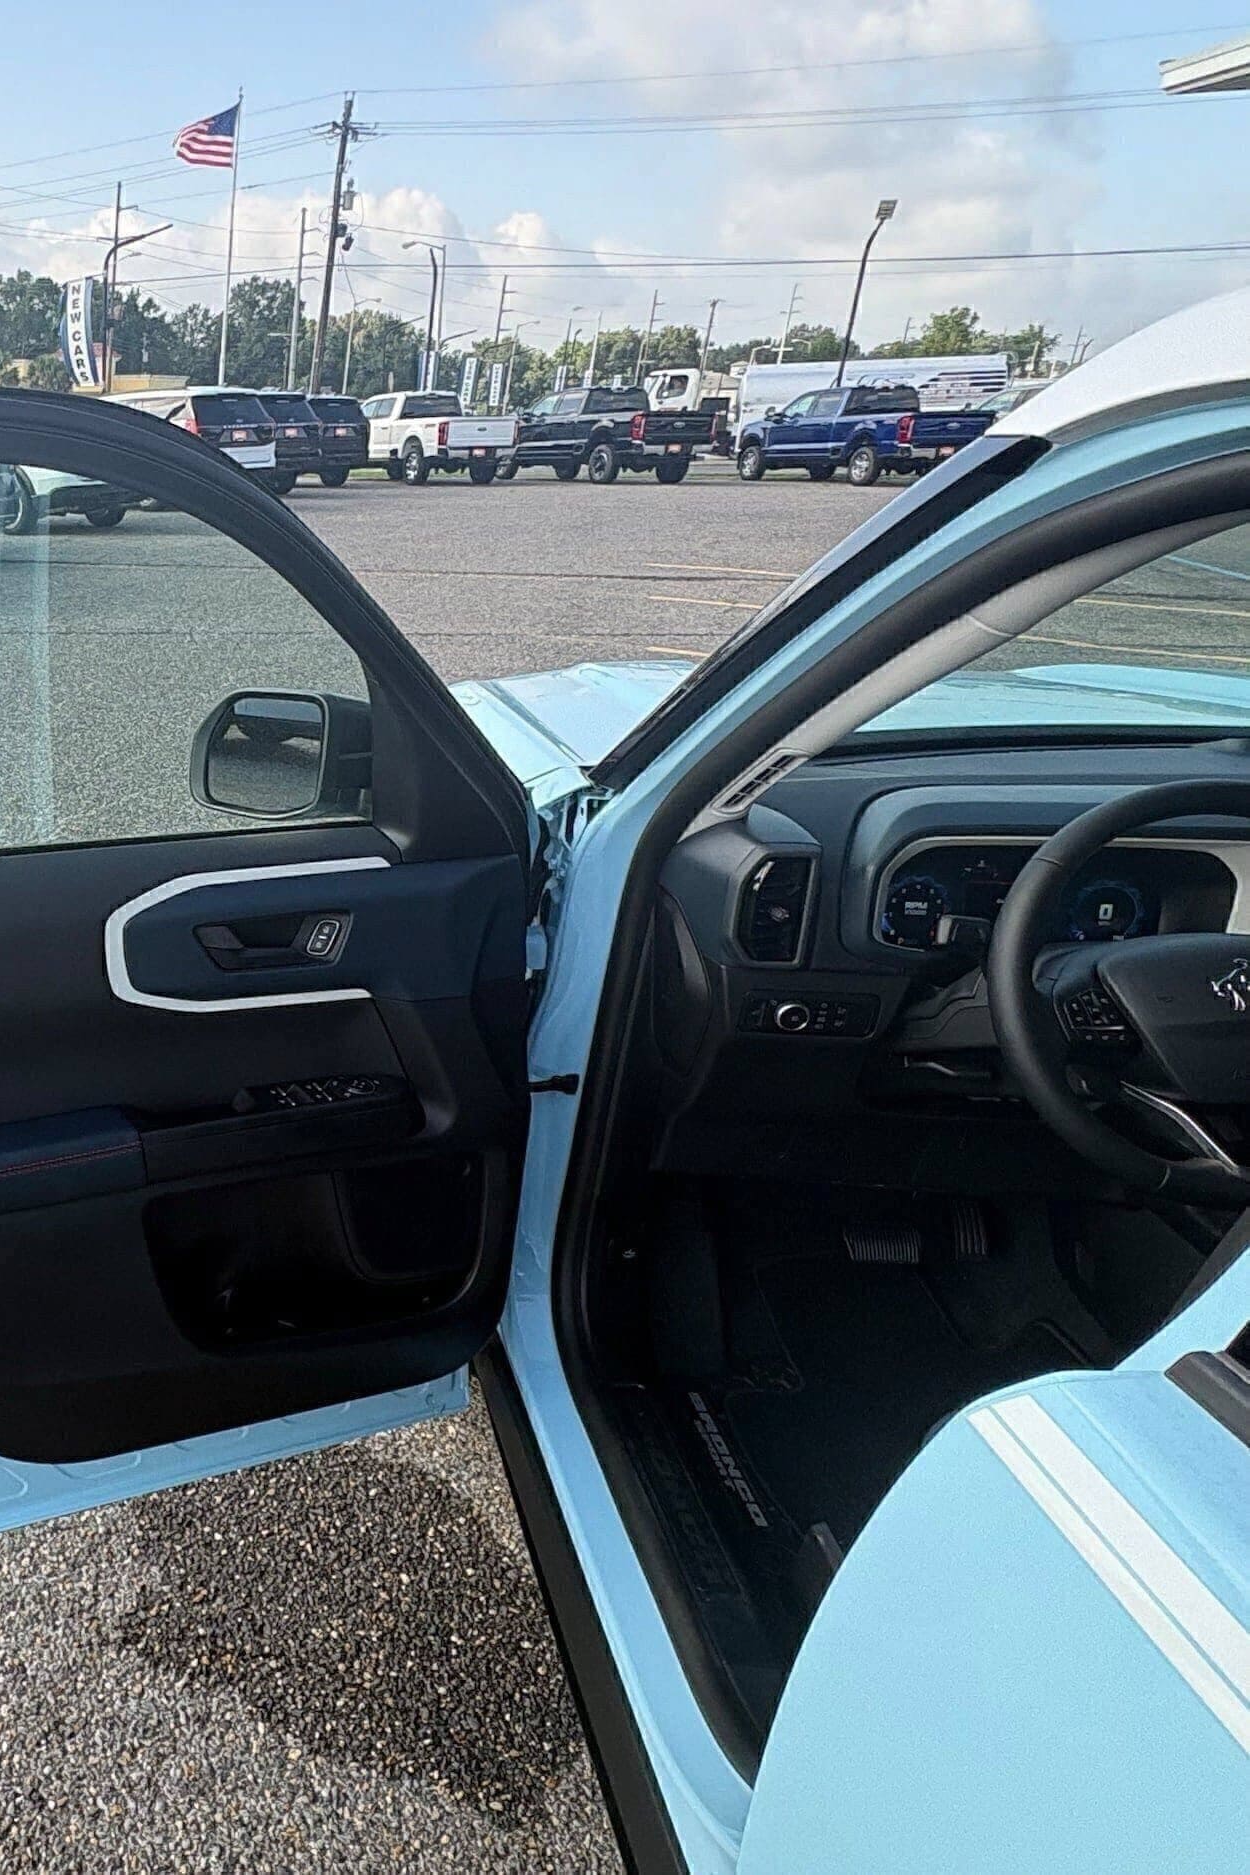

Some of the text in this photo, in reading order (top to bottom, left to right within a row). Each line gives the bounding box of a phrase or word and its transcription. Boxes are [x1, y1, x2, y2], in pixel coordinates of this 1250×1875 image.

[69, 284, 90, 383] NEW CARS
[904, 901, 928, 909] RPM
[1099, 903, 1113, 920] 0
[688, 1392, 769, 1527] BRONCO
